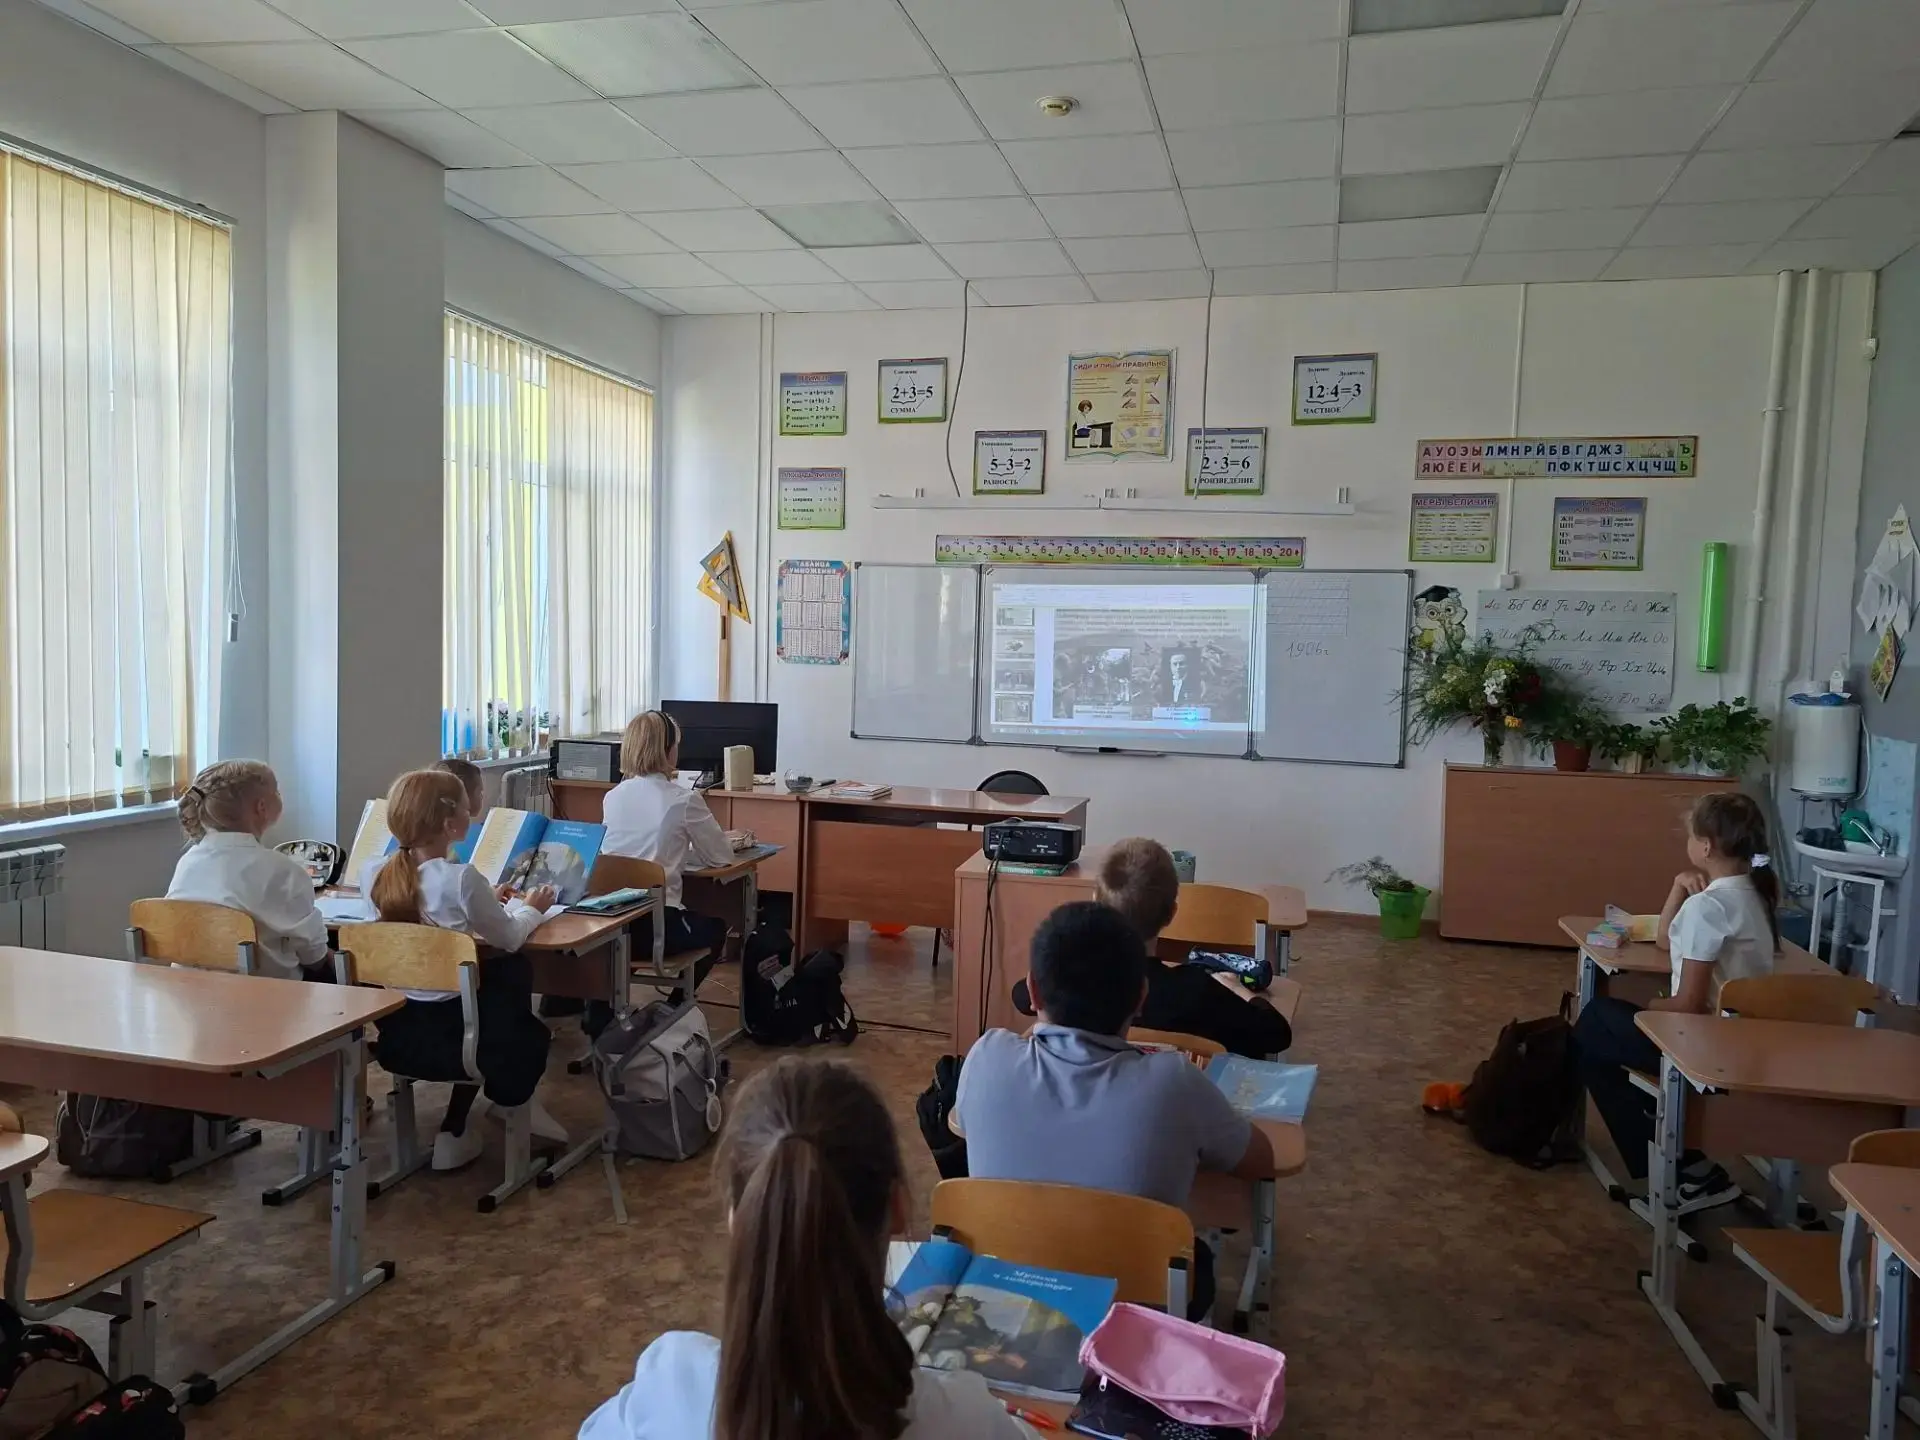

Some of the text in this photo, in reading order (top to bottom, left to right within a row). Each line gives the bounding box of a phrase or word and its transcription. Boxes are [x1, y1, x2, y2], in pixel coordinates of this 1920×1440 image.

[1122, 360, 1167, 368] ПРАВИЛЬНО
[892, 386, 934, 399] 2+3=5
[1415, 498, 1494, 506] МЕРЫ ВЕЛИЧИН
[1105, 546, 1115, 555] 10
[1124, 546, 1131, 555] 11
[1140, 547, 1149, 555] 12
[1157, 547, 1166, 555] 13
[1191, 547, 1200, 556] 15
[1209, 547, 1218, 556] 16
[1226, 547, 1236, 556] 17
[1244, 548, 1254, 556] 18
[1262, 548, 1273, 556] 19
[1279, 548, 1292, 556] 20
[1508, 598, 1530, 610] Бб
[1532, 598, 1549, 611] Вв
[1575, 600, 1595, 616] Дд
[1646, 601, 1670, 613] Жж
[1598, 659, 1617, 675] Фф
[1621, 660, 1643, 673] Хх
